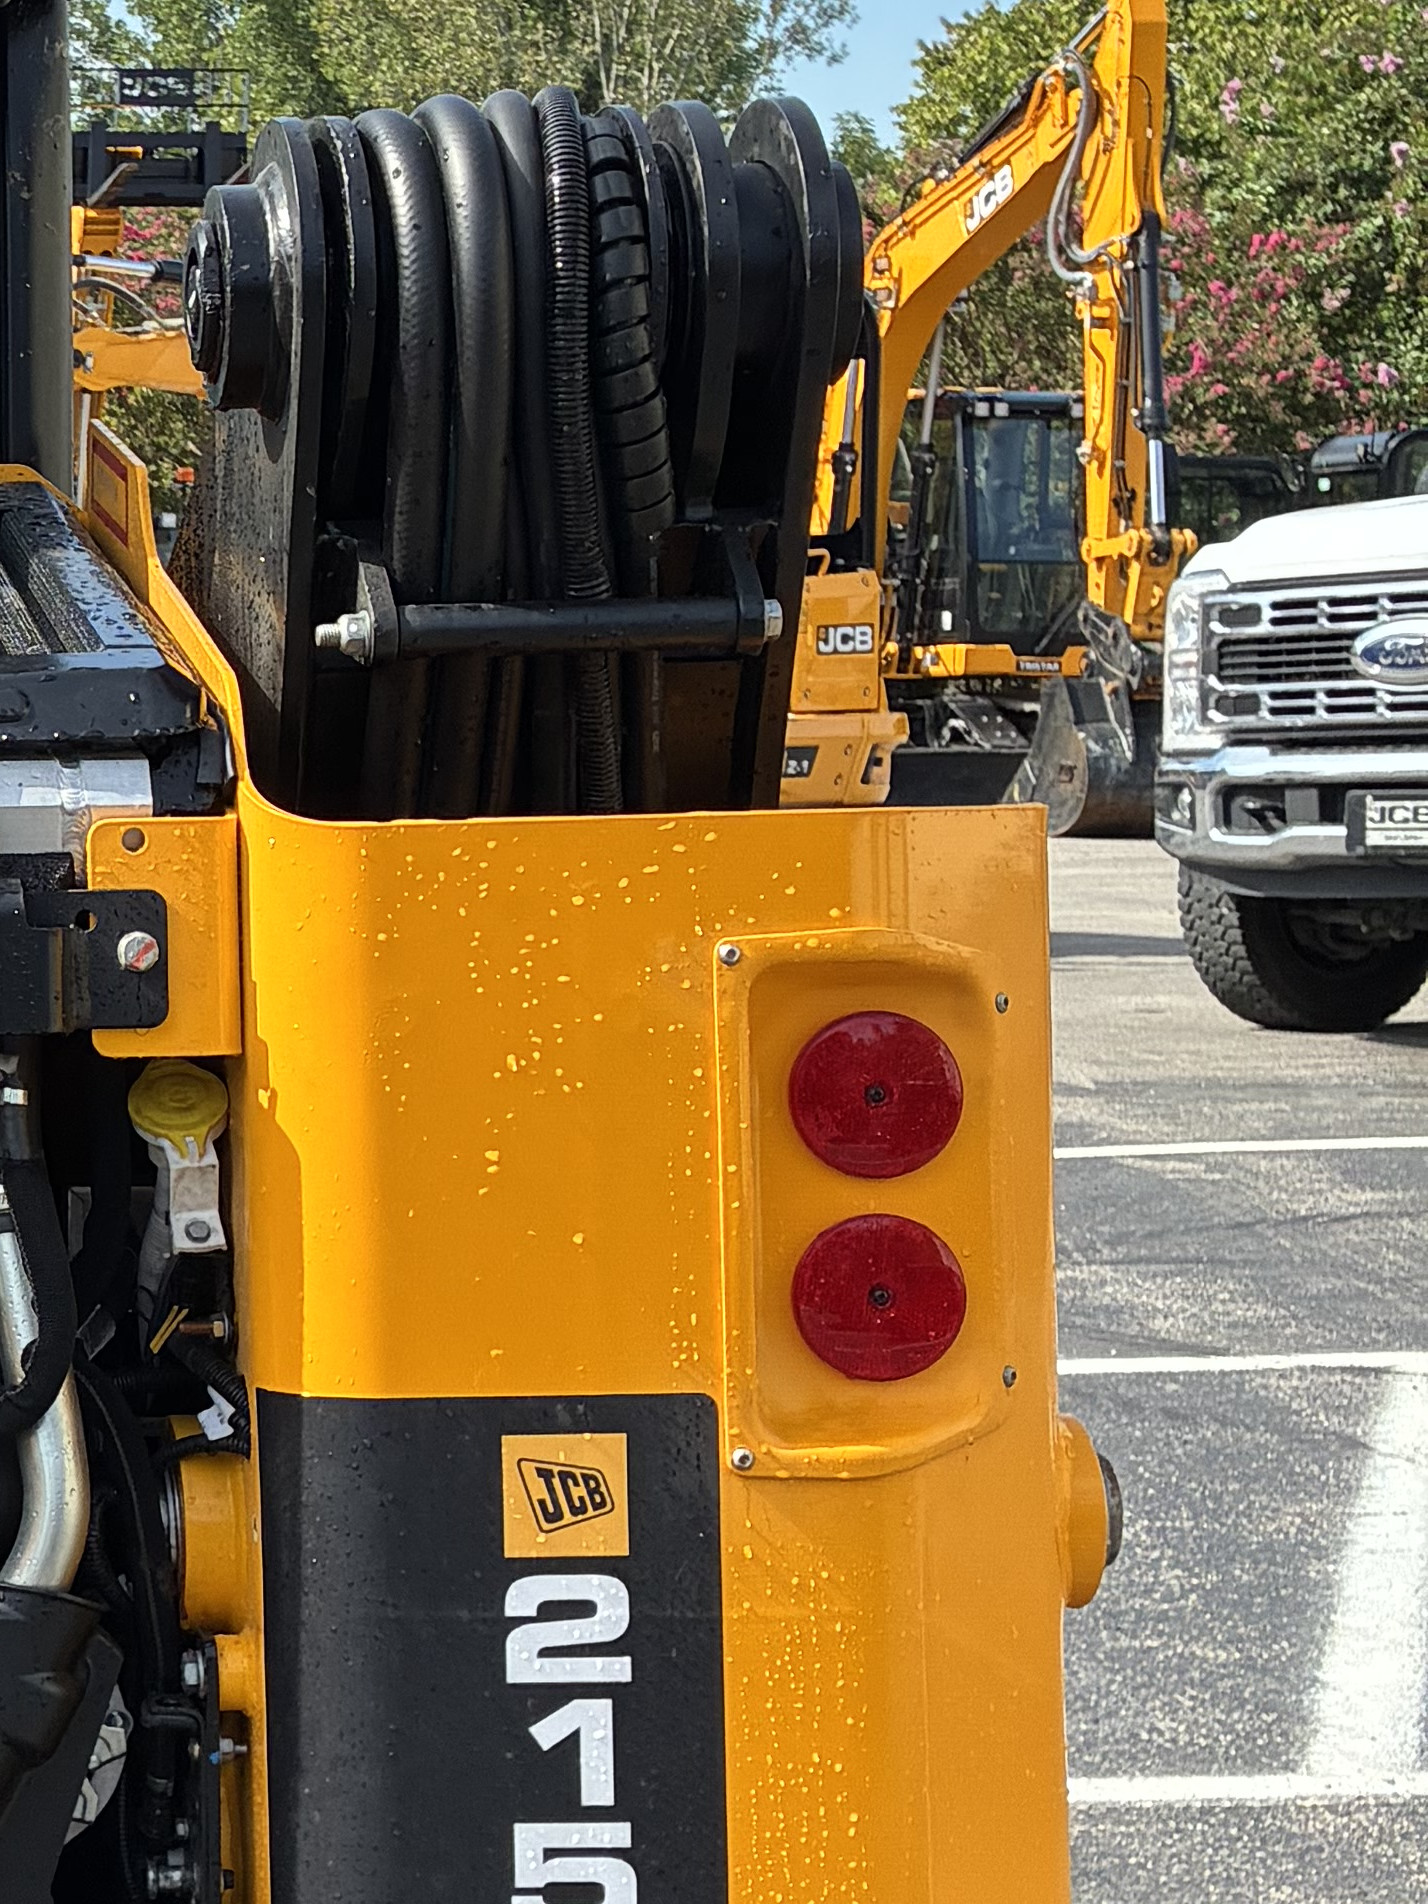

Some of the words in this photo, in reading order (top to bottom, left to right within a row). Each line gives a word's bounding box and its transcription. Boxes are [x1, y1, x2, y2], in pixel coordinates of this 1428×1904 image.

[965, 164, 1014, 233] JCB
[818, 625, 874, 654] JCB
[1378, 637, 1428, 666] For
[536, 1466, 608, 1525] JCB
